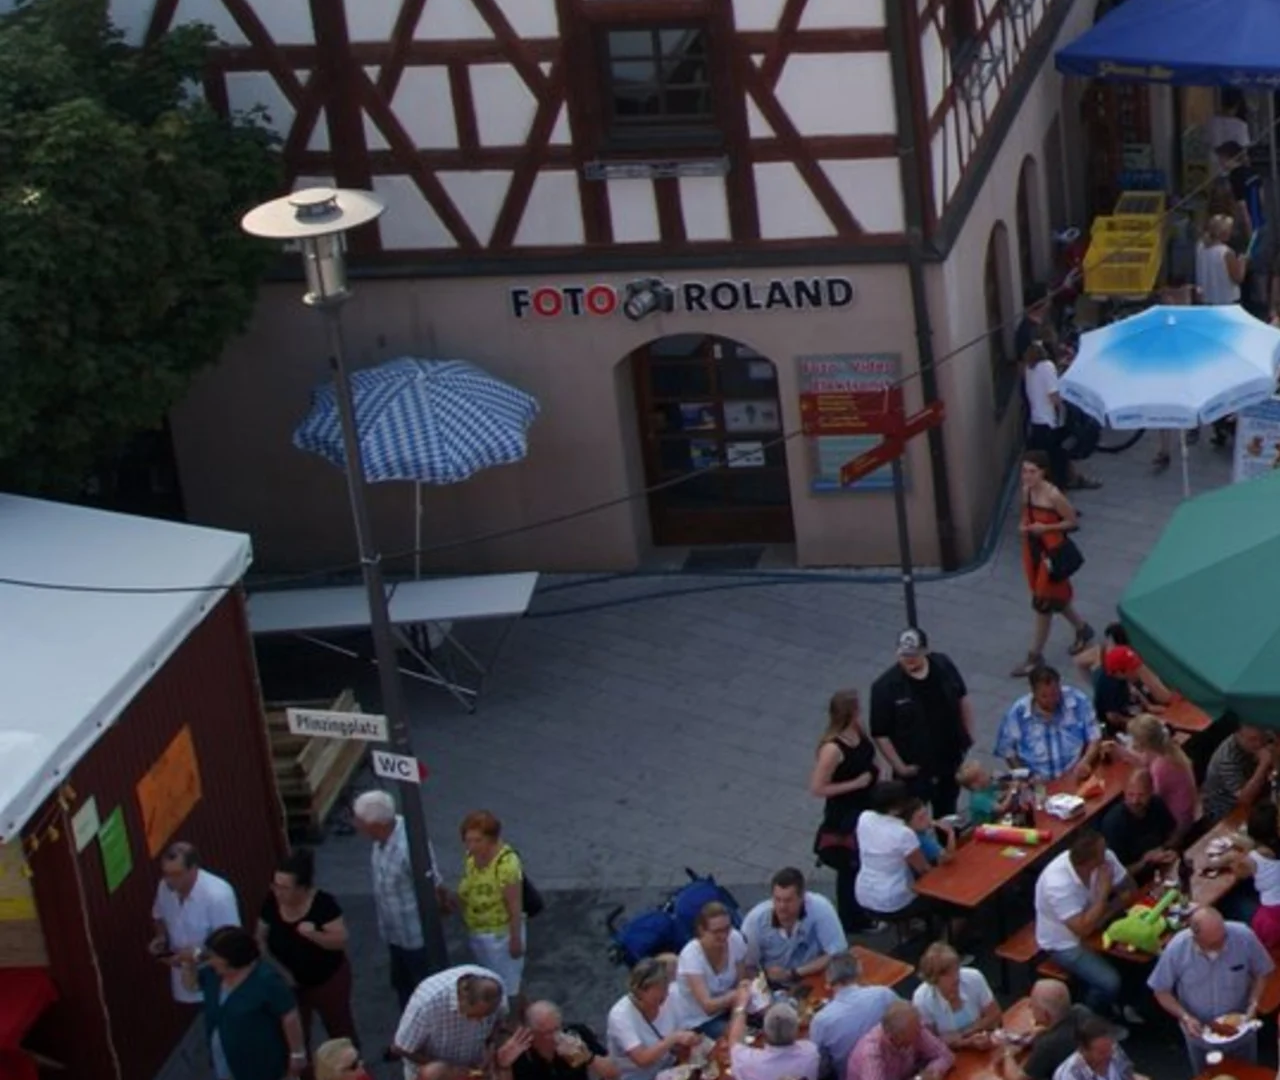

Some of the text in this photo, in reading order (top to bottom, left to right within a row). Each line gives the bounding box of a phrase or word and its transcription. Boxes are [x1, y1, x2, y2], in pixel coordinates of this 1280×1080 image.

[511, 278, 854, 318] FOTO ROLAND
[296, 714, 380, 736] Pfinzingplatz
[377, 756, 411, 777] WC
